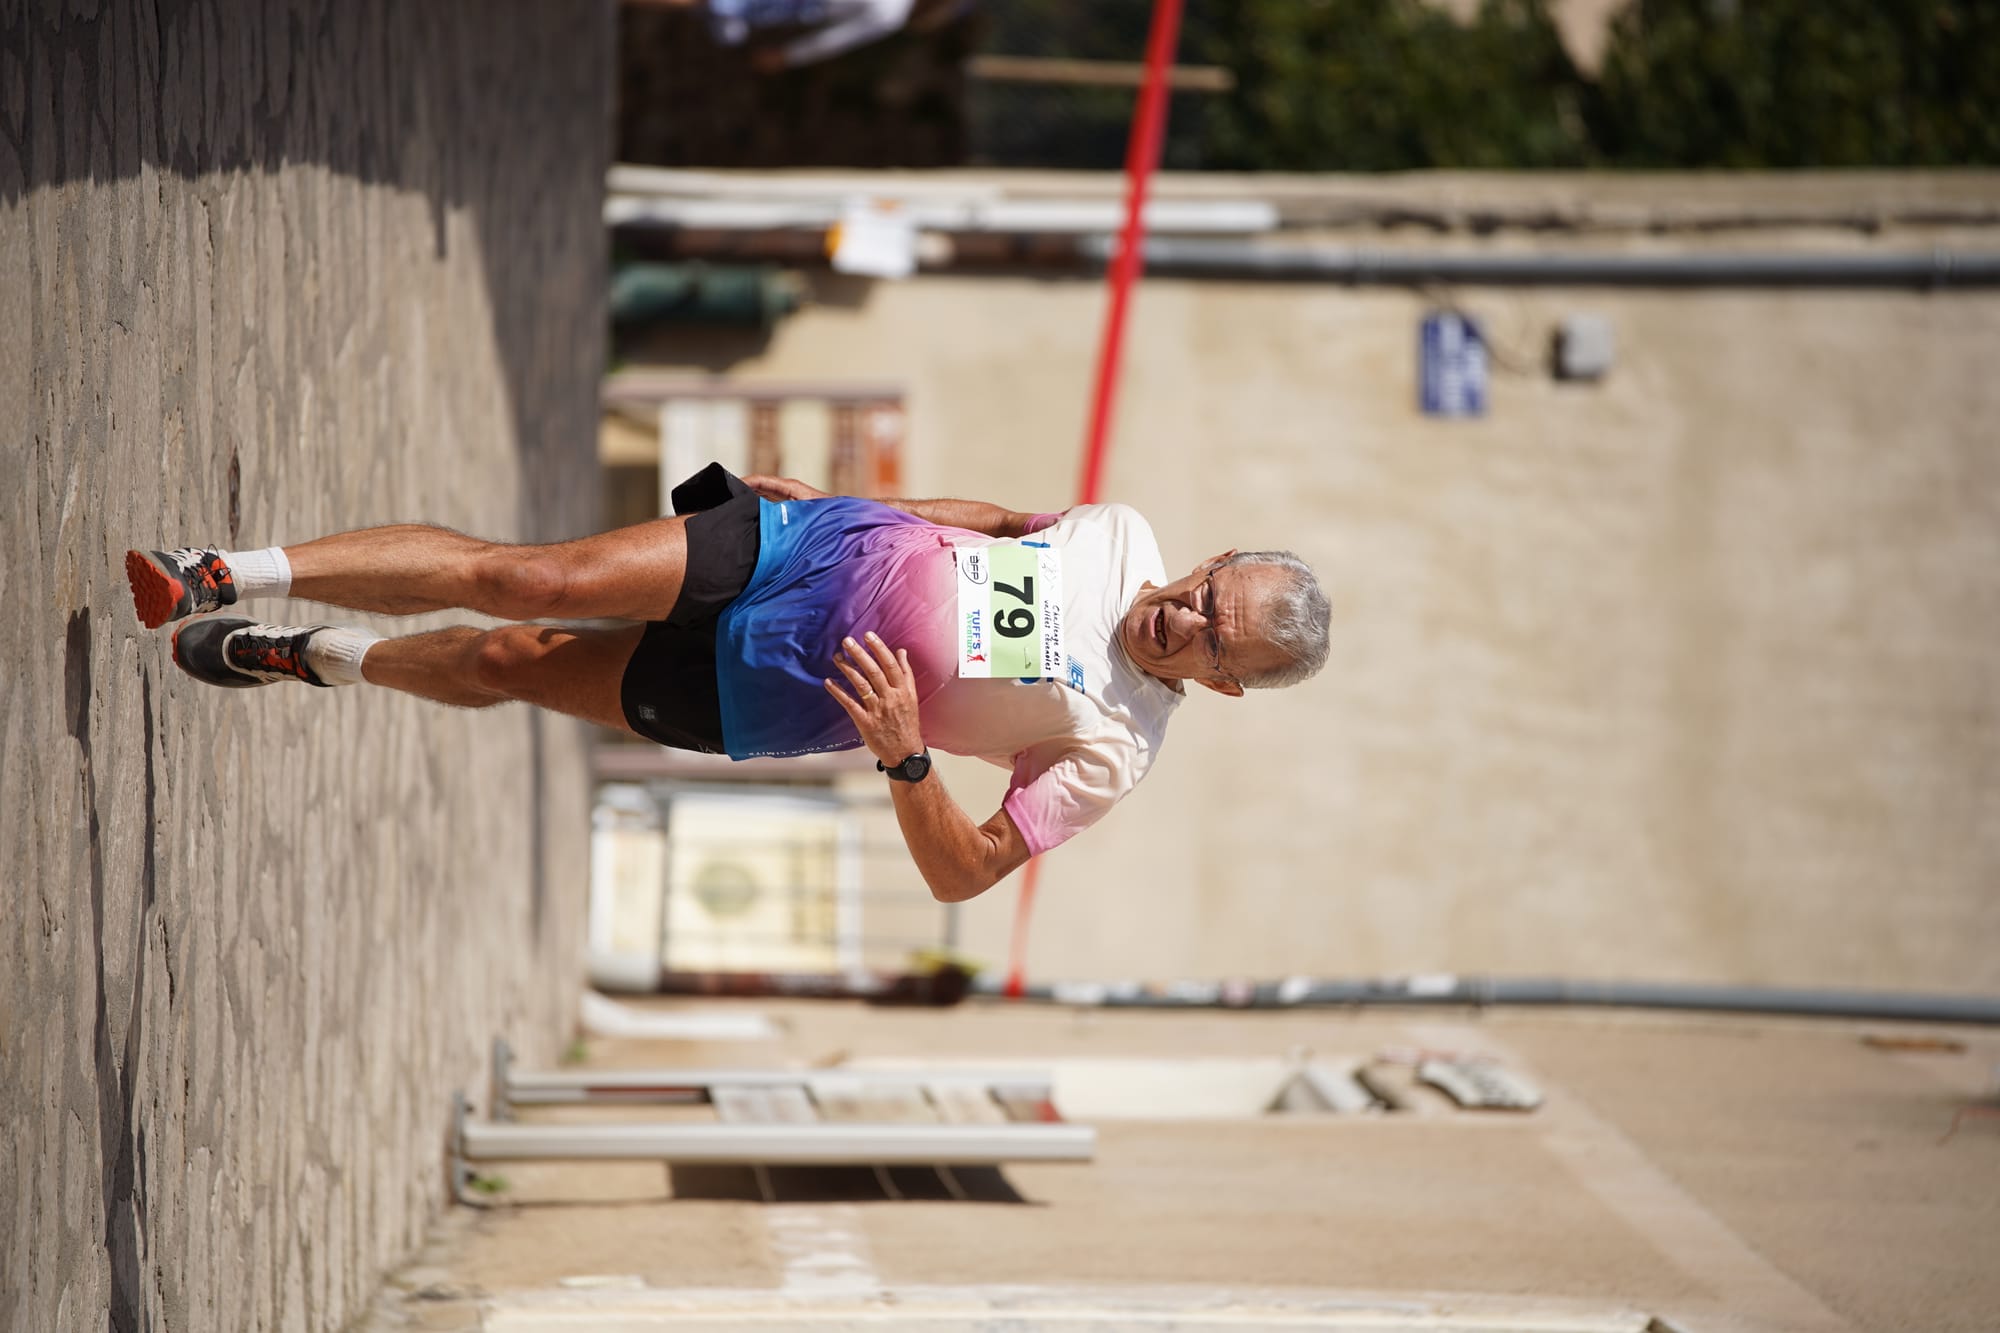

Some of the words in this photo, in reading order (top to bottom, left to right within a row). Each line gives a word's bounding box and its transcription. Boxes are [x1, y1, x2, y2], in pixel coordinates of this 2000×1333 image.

[994, 576, 1035, 638] 79
[1051, 605, 1060, 646] Challenge
[966, 612, 974, 654] Aventure
[972, 609, 981, 650] TUFF'S
[1053, 651, 1061, 666] des
